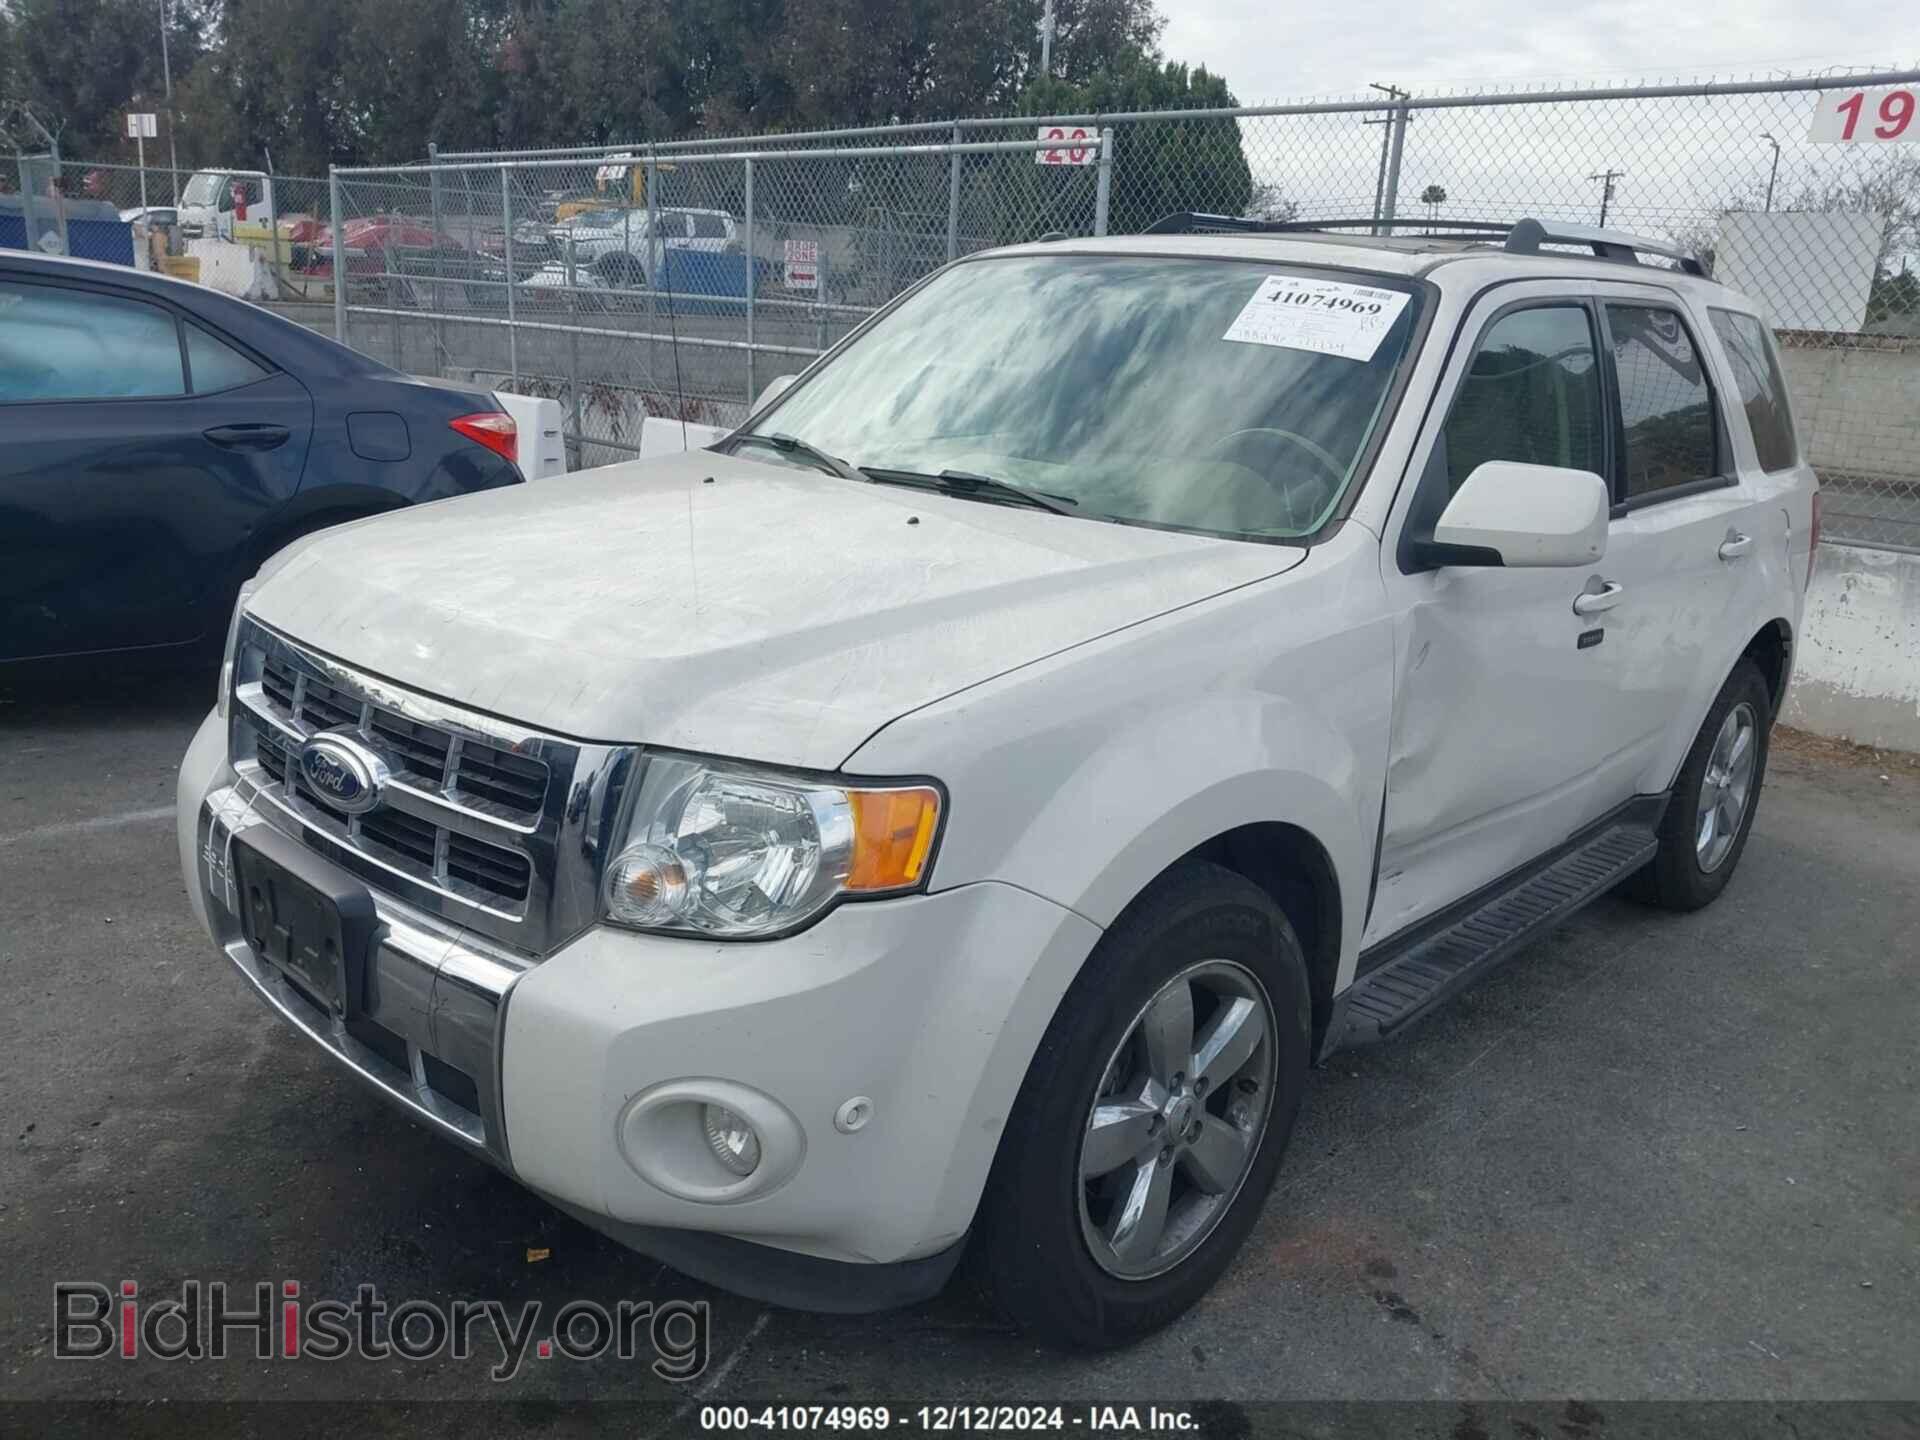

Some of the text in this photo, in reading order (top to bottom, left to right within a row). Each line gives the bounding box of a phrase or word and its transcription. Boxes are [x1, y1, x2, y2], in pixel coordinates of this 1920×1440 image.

[1836, 91, 1916, 140] 19
[1045, 128, 1087, 163] 20
[786, 251, 816, 261] ZONE
[1267, 290, 1382, 316] 41074969
[311, 751, 344, 792] Ford
